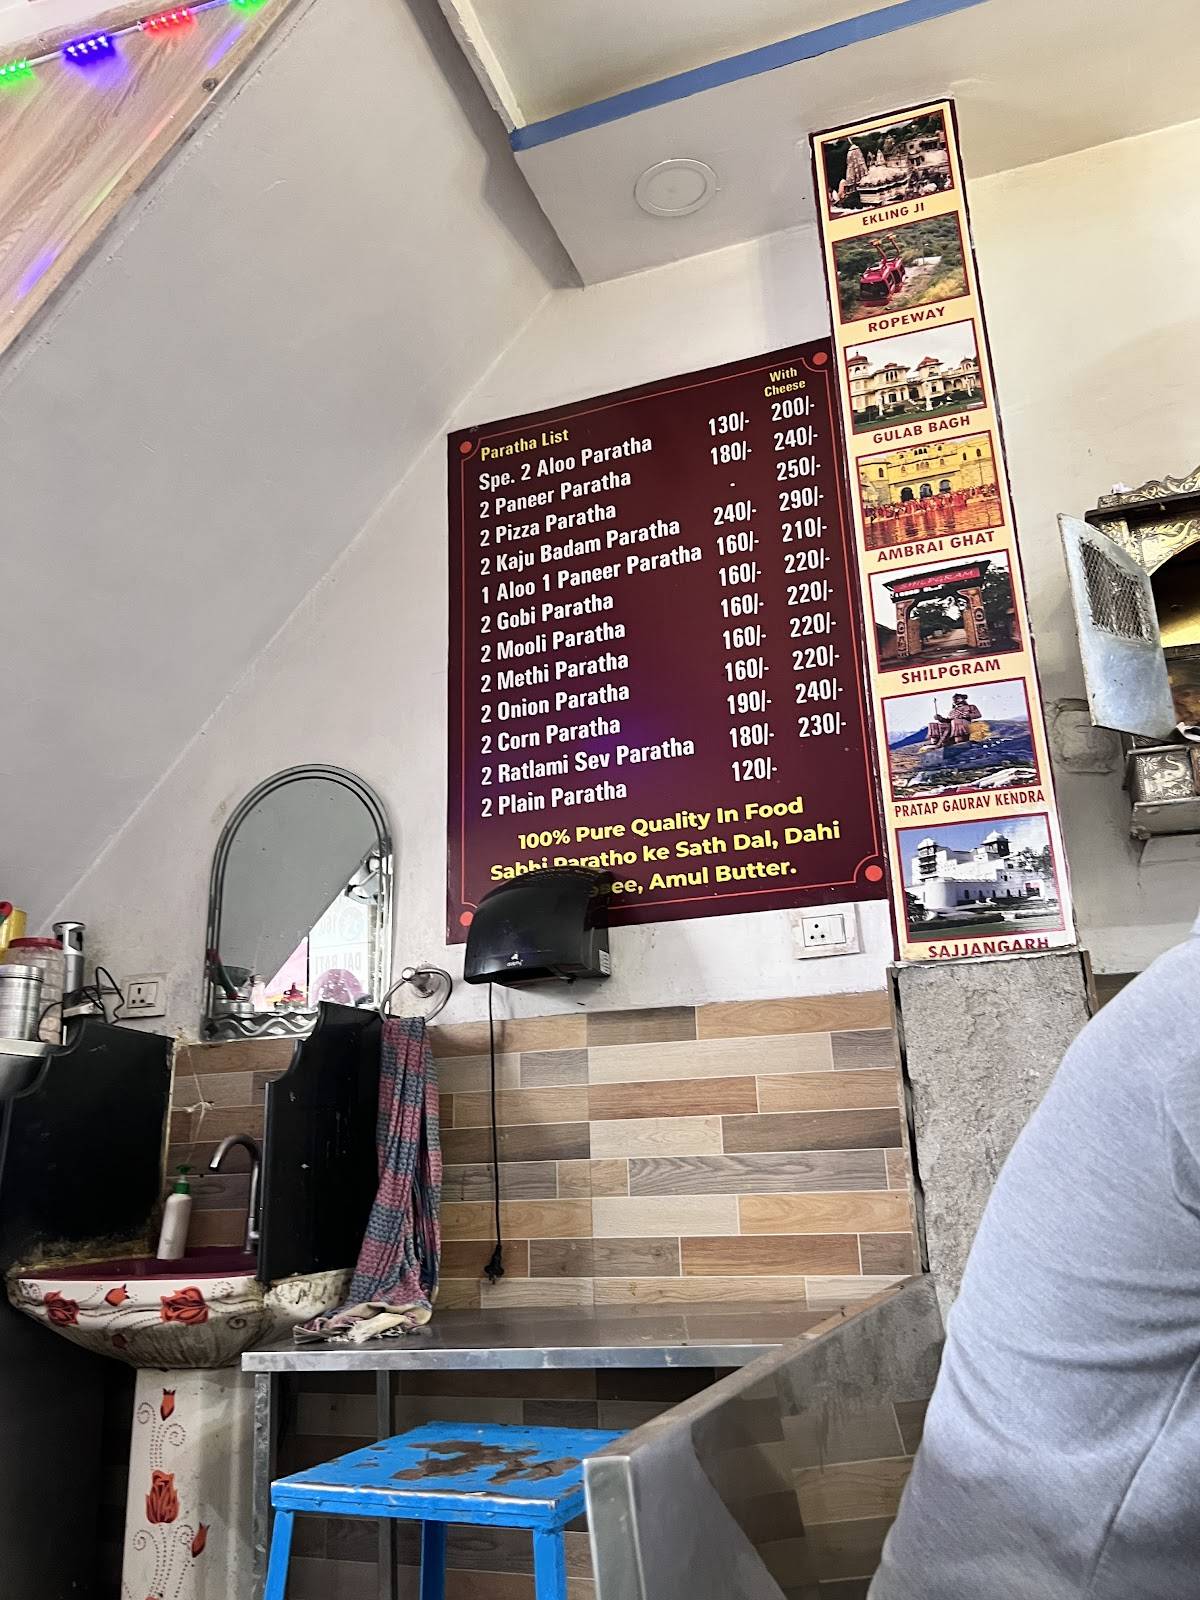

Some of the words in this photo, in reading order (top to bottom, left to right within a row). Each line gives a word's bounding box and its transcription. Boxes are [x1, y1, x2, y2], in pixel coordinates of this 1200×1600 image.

[862, 206, 909, 226] EKLING
[913, 202, 925, 215] JI
[868, 306, 945, 332] ROPEWAY
[764, 380, 805, 397] Cheese
[769, 367, 797, 382] With
[479, 472, 515, 492] Spe.
[520, 463, 532, 481] 2
[537, 457, 575, 477] Aloo
[581, 437, 652, 466] Paratha
[708, 411, 749, 436] 130/-
[771, 395, 815, 421] 200/-
[481, 438, 537, 461] Paratha
[542, 429, 568, 446] List
[873, 425, 922, 444] GULAB
[928, 415, 971, 432] BAGH
[479, 501, 490, 518] 2
[496, 490, 554, 515] Paneer
[560, 471, 631, 500] Paratha
[710, 440, 752, 465] 180/-
[773, 425, 818, 451] 240/-
[479, 529, 491, 547] 2
[496, 522, 539, 543] Pizza
[546, 504, 616, 532] Paratha
[776, 455, 821, 481] 250/-
[479, 557, 491, 575] 2
[497, 550, 534, 572] Kaju
[540, 538, 601, 563] Badam
[606, 519, 680, 548] Paratha
[713, 500, 756, 525] 240/-
[779, 486, 824, 511] 290/-
[877, 540, 944, 562] AMBRAI
[949, 530, 995, 549] GHAT
[481, 586, 489, 603] 1
[497, 581, 535, 601] Aloo
[541, 574, 551, 591] 1
[558, 563, 621, 589] Paneer
[627, 545, 702, 574] Paratha
[716, 530, 759, 555] 160/-
[781, 516, 827, 542] 210/-
[480, 615, 492, 633] 2
[497, 606, 535, 630] Gobi
[542, 594, 613, 621] Paratha
[718, 561, 761, 586] 160/-
[784, 548, 830, 573] 220/-
[480, 644, 492, 663] 2
[497, 634, 546, 660] Mooli
[553, 622, 625, 650] Paratha
[721, 593, 764, 617] 160/-
[786, 580, 833, 605] 220/-
[480, 674, 492, 693] 2
[497, 663, 549, 690] Methi
[555, 652, 628, 680] Paratha
[723, 625, 766, 649] 160/-
[789, 612, 836, 638] 220/-
[901, 659, 1000, 684] SHILPGRAM
[480, 704, 492, 723] 2
[498, 698, 549, 720] Onion
[555, 683, 629, 711] Paratha
[725, 657, 769, 682] 160/-
[792, 644, 839, 670] 220/-
[480, 735, 493, 754] 2
[498, 732, 540, 751] Corn
[546, 716, 620, 744] Paratha
[727, 689, 772, 714] 190/-
[795, 677, 843, 704] 240/-
[480, 766, 493, 785] 2
[498, 754, 568, 783] Ratlami
[575, 751, 610, 771] Sev
[616, 737, 694, 765] Paratha
[729, 723, 774, 748] 180/-
[798, 712, 846, 737] 230/-
[480, 798, 493, 817] 2
[498, 791, 545, 815] Plain
[551, 780, 627, 807] Paratha
[732, 757, 777, 781] 120/-
[895, 802, 939, 817] PRATAP
[943, 795, 990, 812] GAURAV
[995, 788, 1045, 806] KENDRA
[518, 829, 570, 849] 100%
[576, 824, 625, 842] Pure
[631, 810, 710, 837] Quality
[717, 808, 738, 823] In
[745, 796, 803, 820] Food
[553, 850, 637, 868] Paratho
[642, 845, 670, 862] ke
[675, 836, 727, 858] Sath
[733, 830, 778, 850] Dal,
[784, 820, 840, 844] Dahi
[649, 866, 708, 890] Amul
[715, 861, 796, 882] Butter.
[928, 938, 1049, 958] SAJJANGARH
